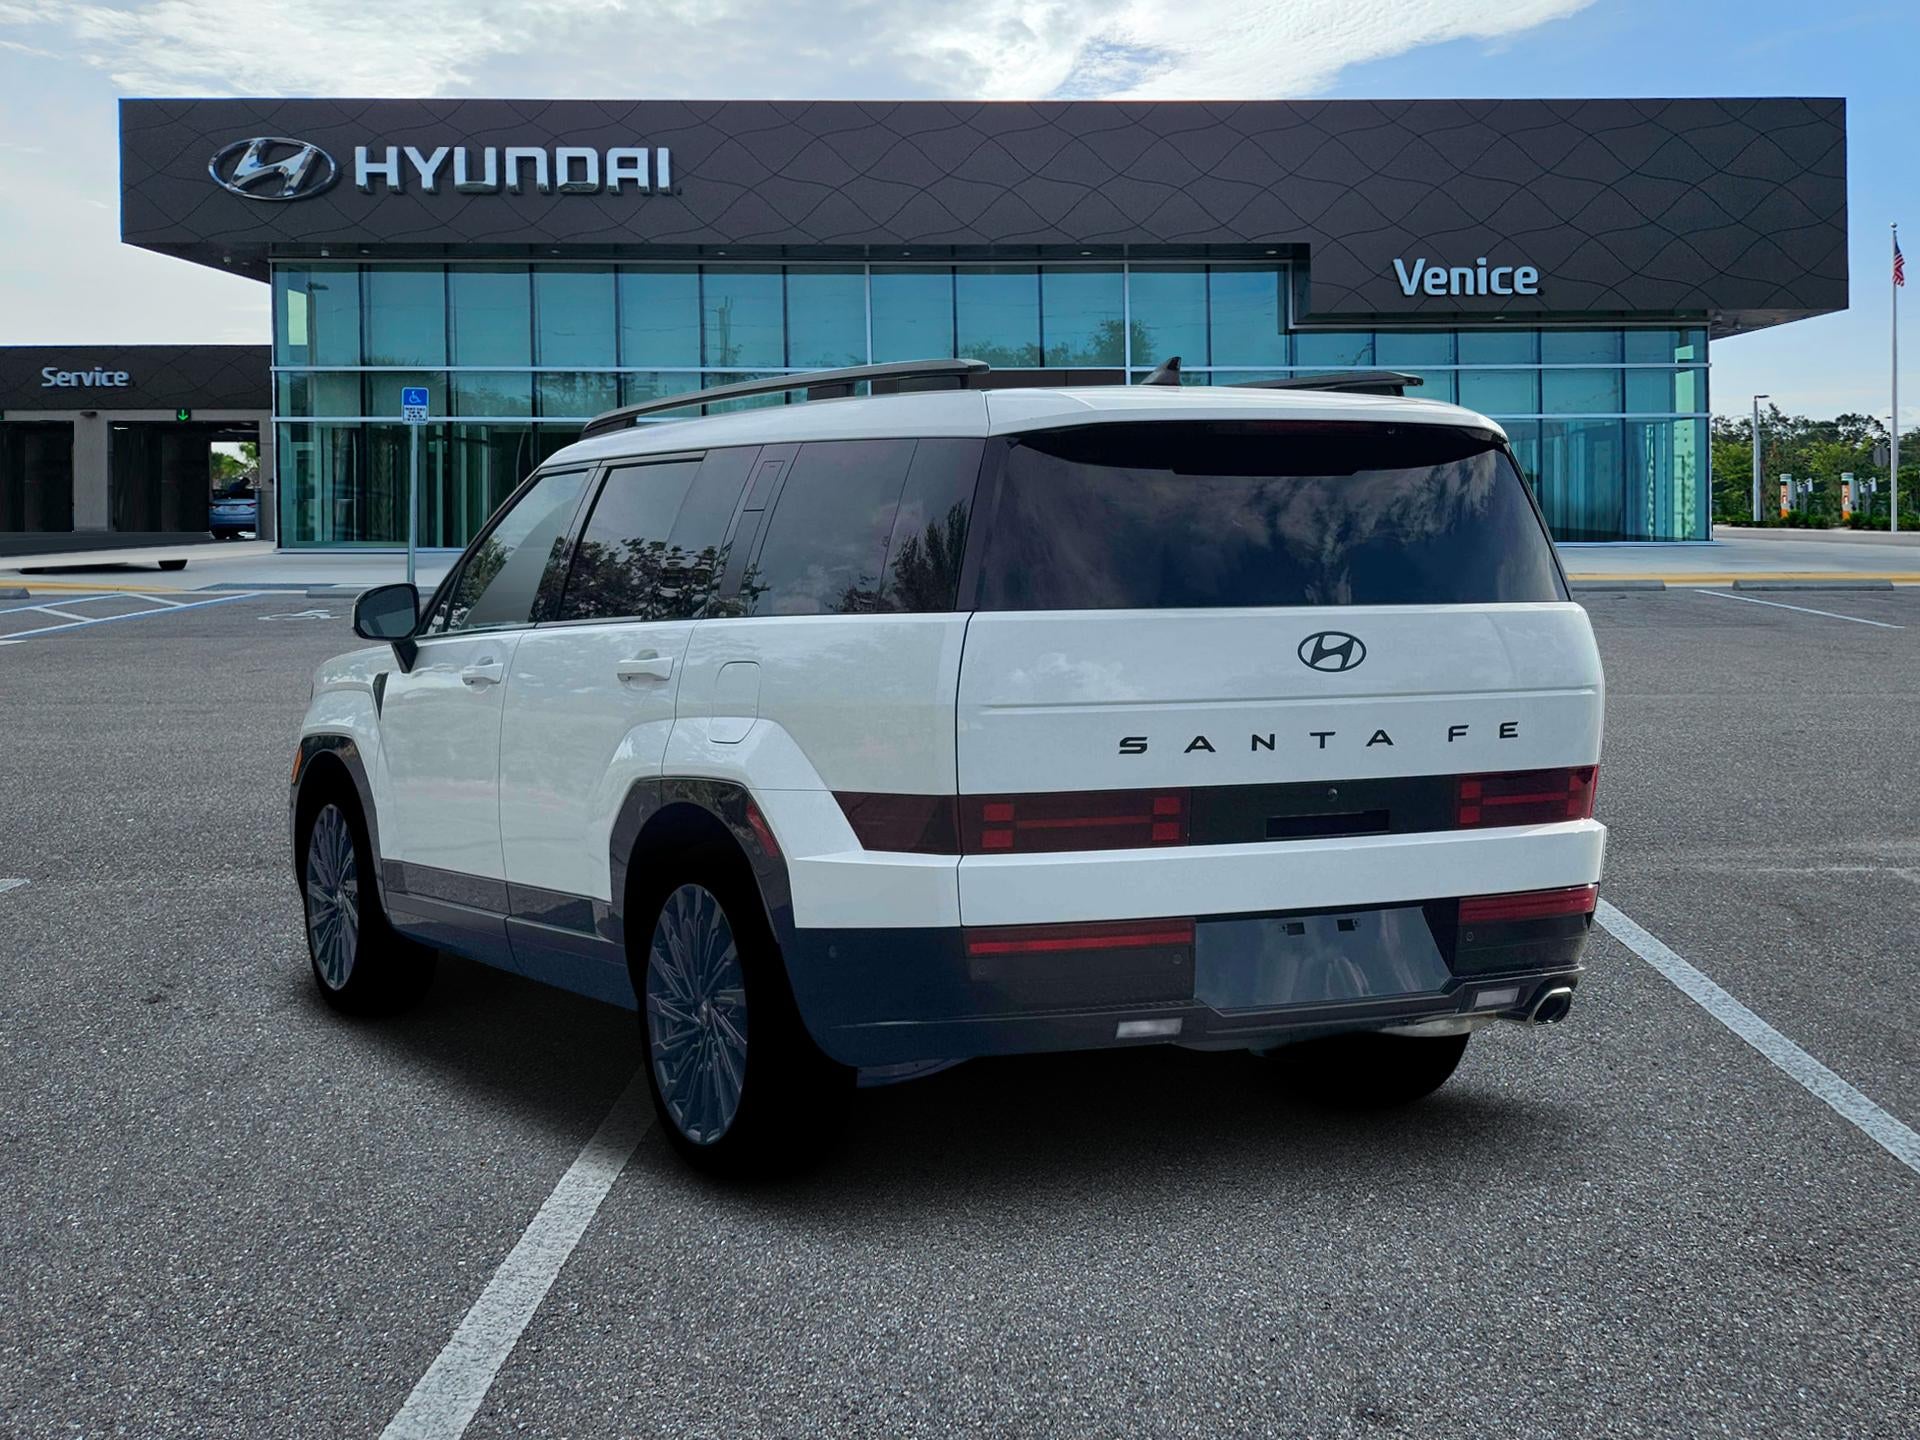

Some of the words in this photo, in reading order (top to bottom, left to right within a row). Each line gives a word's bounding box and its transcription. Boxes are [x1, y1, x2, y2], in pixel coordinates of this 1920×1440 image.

[354, 146, 670, 194] HYUNDAI
[1393, 257, 1538, 296] Venice
[41, 366, 129, 387] Service
[1119, 729, 1394, 755] SANTA
[1447, 721, 1519, 743] FE
